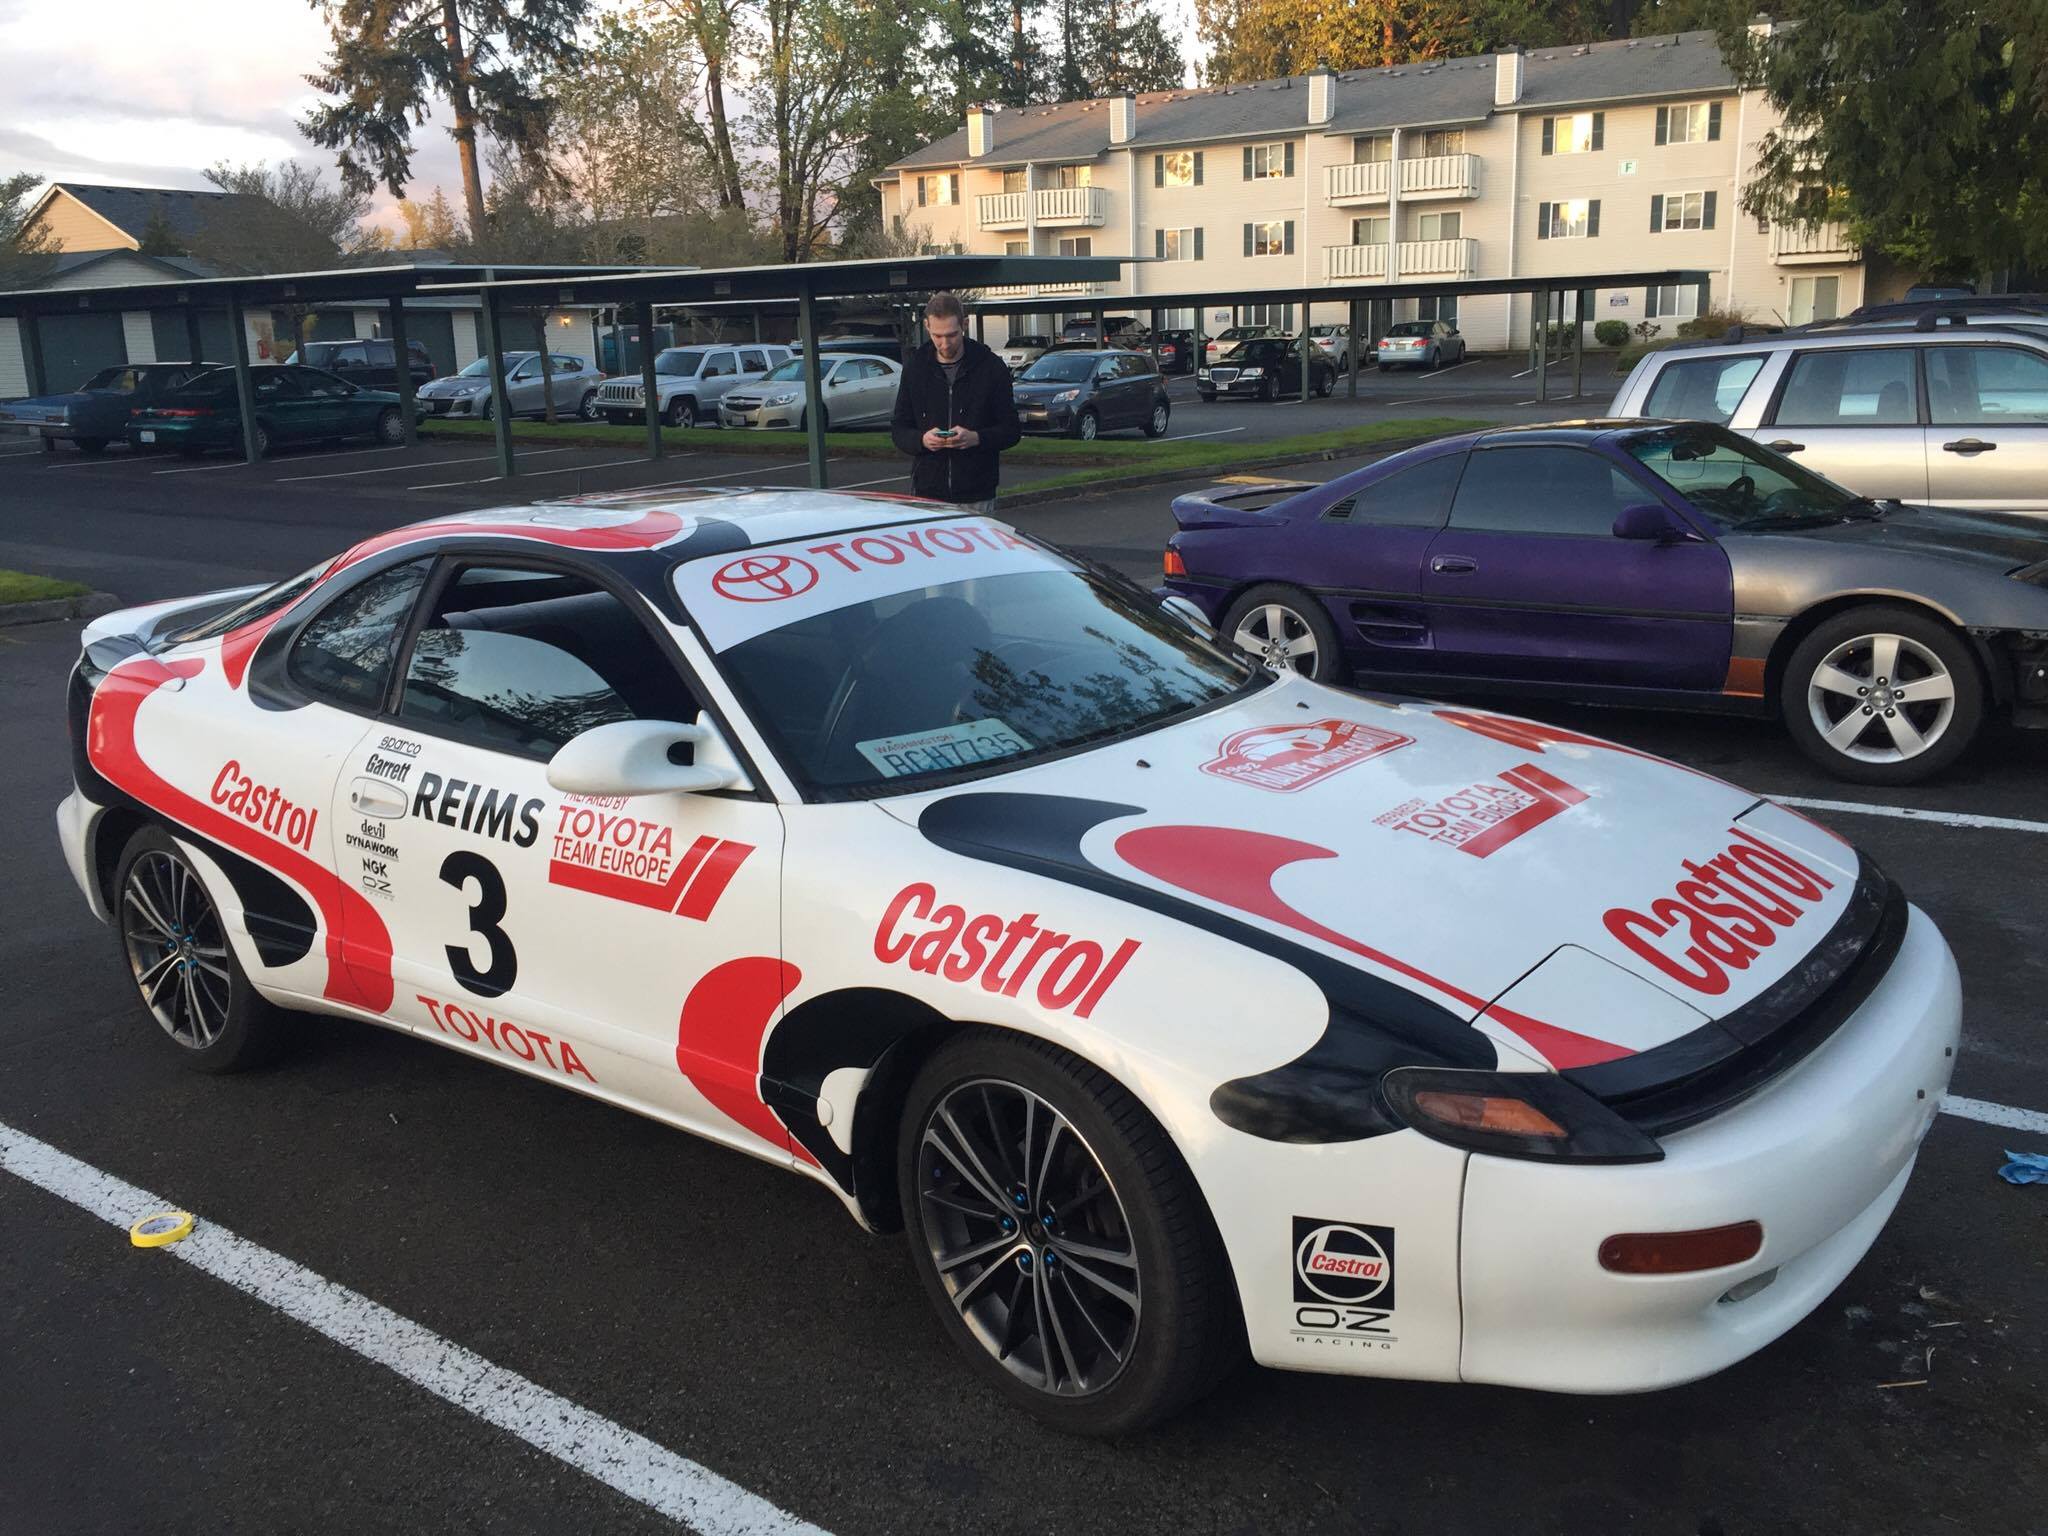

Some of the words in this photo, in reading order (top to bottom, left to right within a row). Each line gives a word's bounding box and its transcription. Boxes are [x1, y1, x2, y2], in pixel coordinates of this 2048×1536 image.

[1625, 162, 1633, 173] F
[807, 527, 1038, 573] TOYOTA
[380, 736, 422, 755] sparco
[365, 753, 411, 783] Garrett
[211, 759, 318, 852] Castrol
[411, 771, 545, 849] REIMS
[613, 795, 631, 811] BY
[1392, 784, 1510, 837] TOYOTA
[346, 834, 399, 859] DYNAWORK
[361, 819, 386, 839] devil
[559, 805, 673, 857] TOYOTA
[1429, 818, 1480, 847] TEAM
[362, 857, 388, 878] NGK
[554, 835, 597, 867] TEAM
[599, 846, 671, 883] EUROPE
[439, 850, 517, 999] 3
[1602, 826, 1834, 995] Castrol
[874, 882, 1142, 1019] Castrol
[416, 993, 598, 1083] TOYOTA
[1311, 1254, 1383, 1277] Castrol
[1296, 1336, 1391, 1350] RACING
